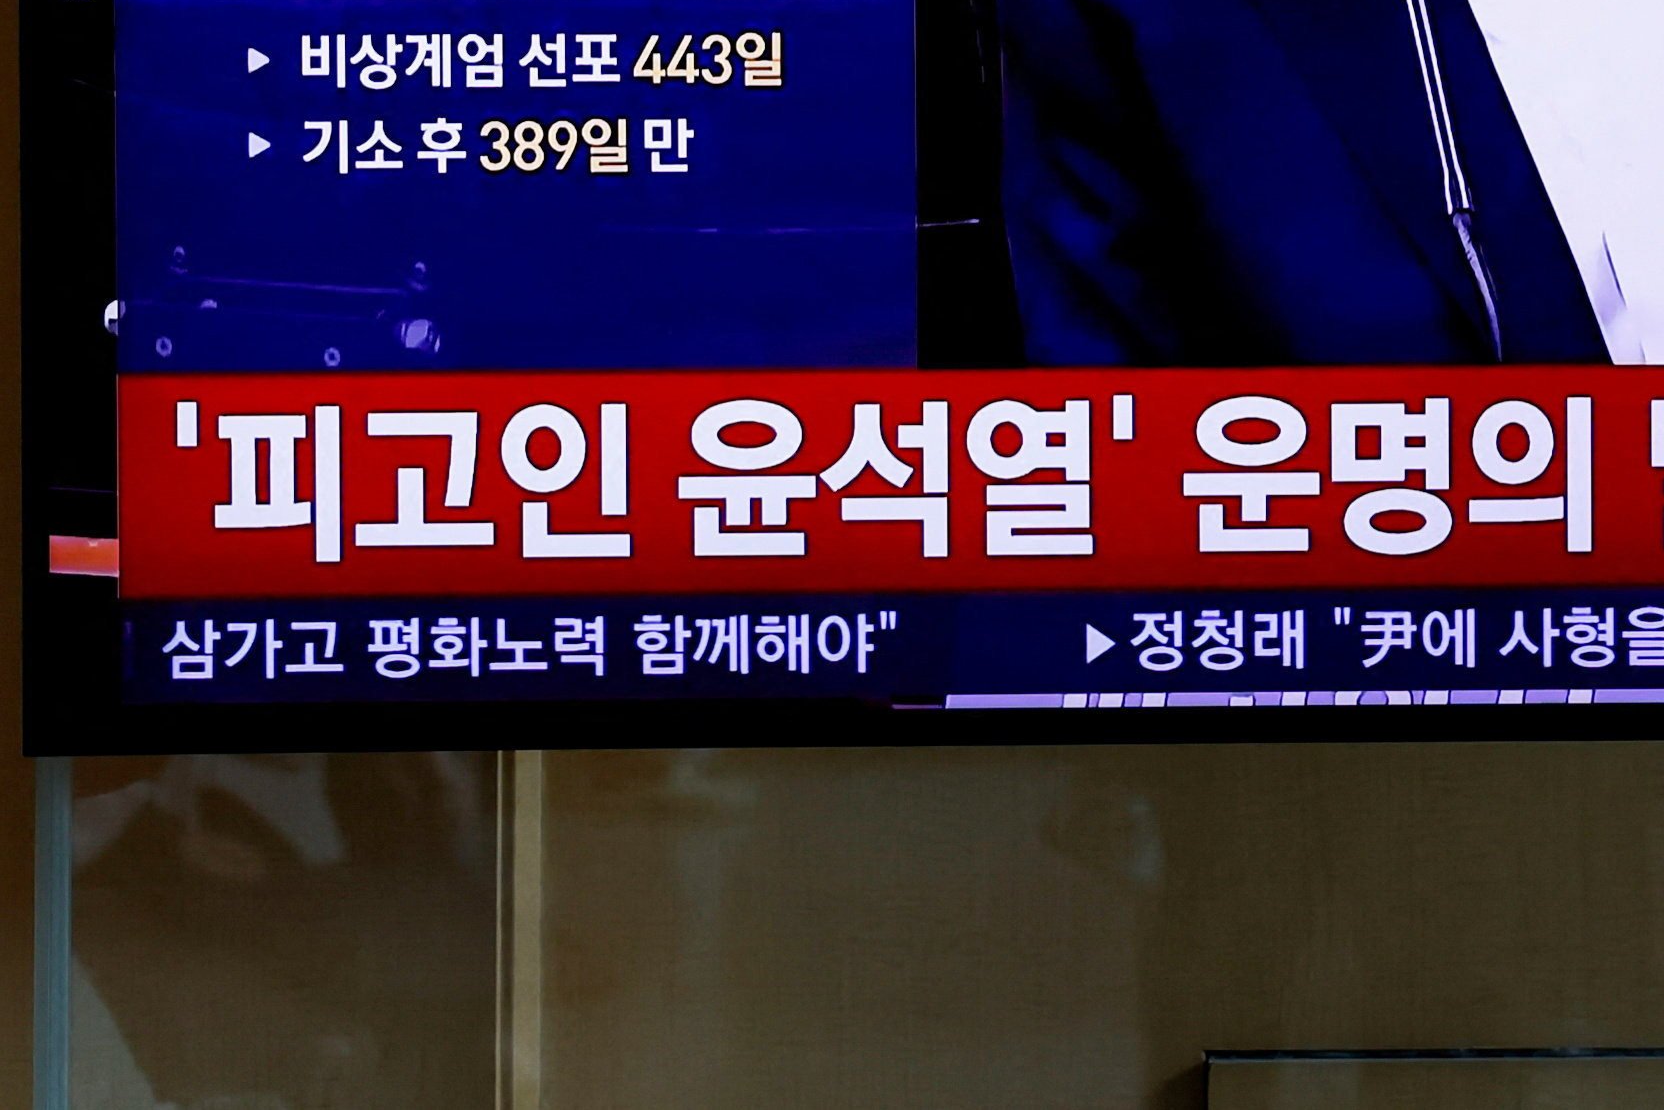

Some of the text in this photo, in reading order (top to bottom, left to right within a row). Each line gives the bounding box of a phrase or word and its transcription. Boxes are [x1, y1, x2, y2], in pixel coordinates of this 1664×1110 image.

[302, 33, 781, 89] 비상계엄 선포 443일
[303, 118, 694, 173] 기소 후 389일 만
[177, 402, 630, 562] '피고인
[679, 395, 1132, 557] 윤석열'
[1184, 397, 1591, 554] 운명의
[163, 611, 896, 678] 삼가고 평화노력 함께해야"
[1131, 610, 1303, 670] 정청래
[1335, 607, 1474, 667] "尹에
